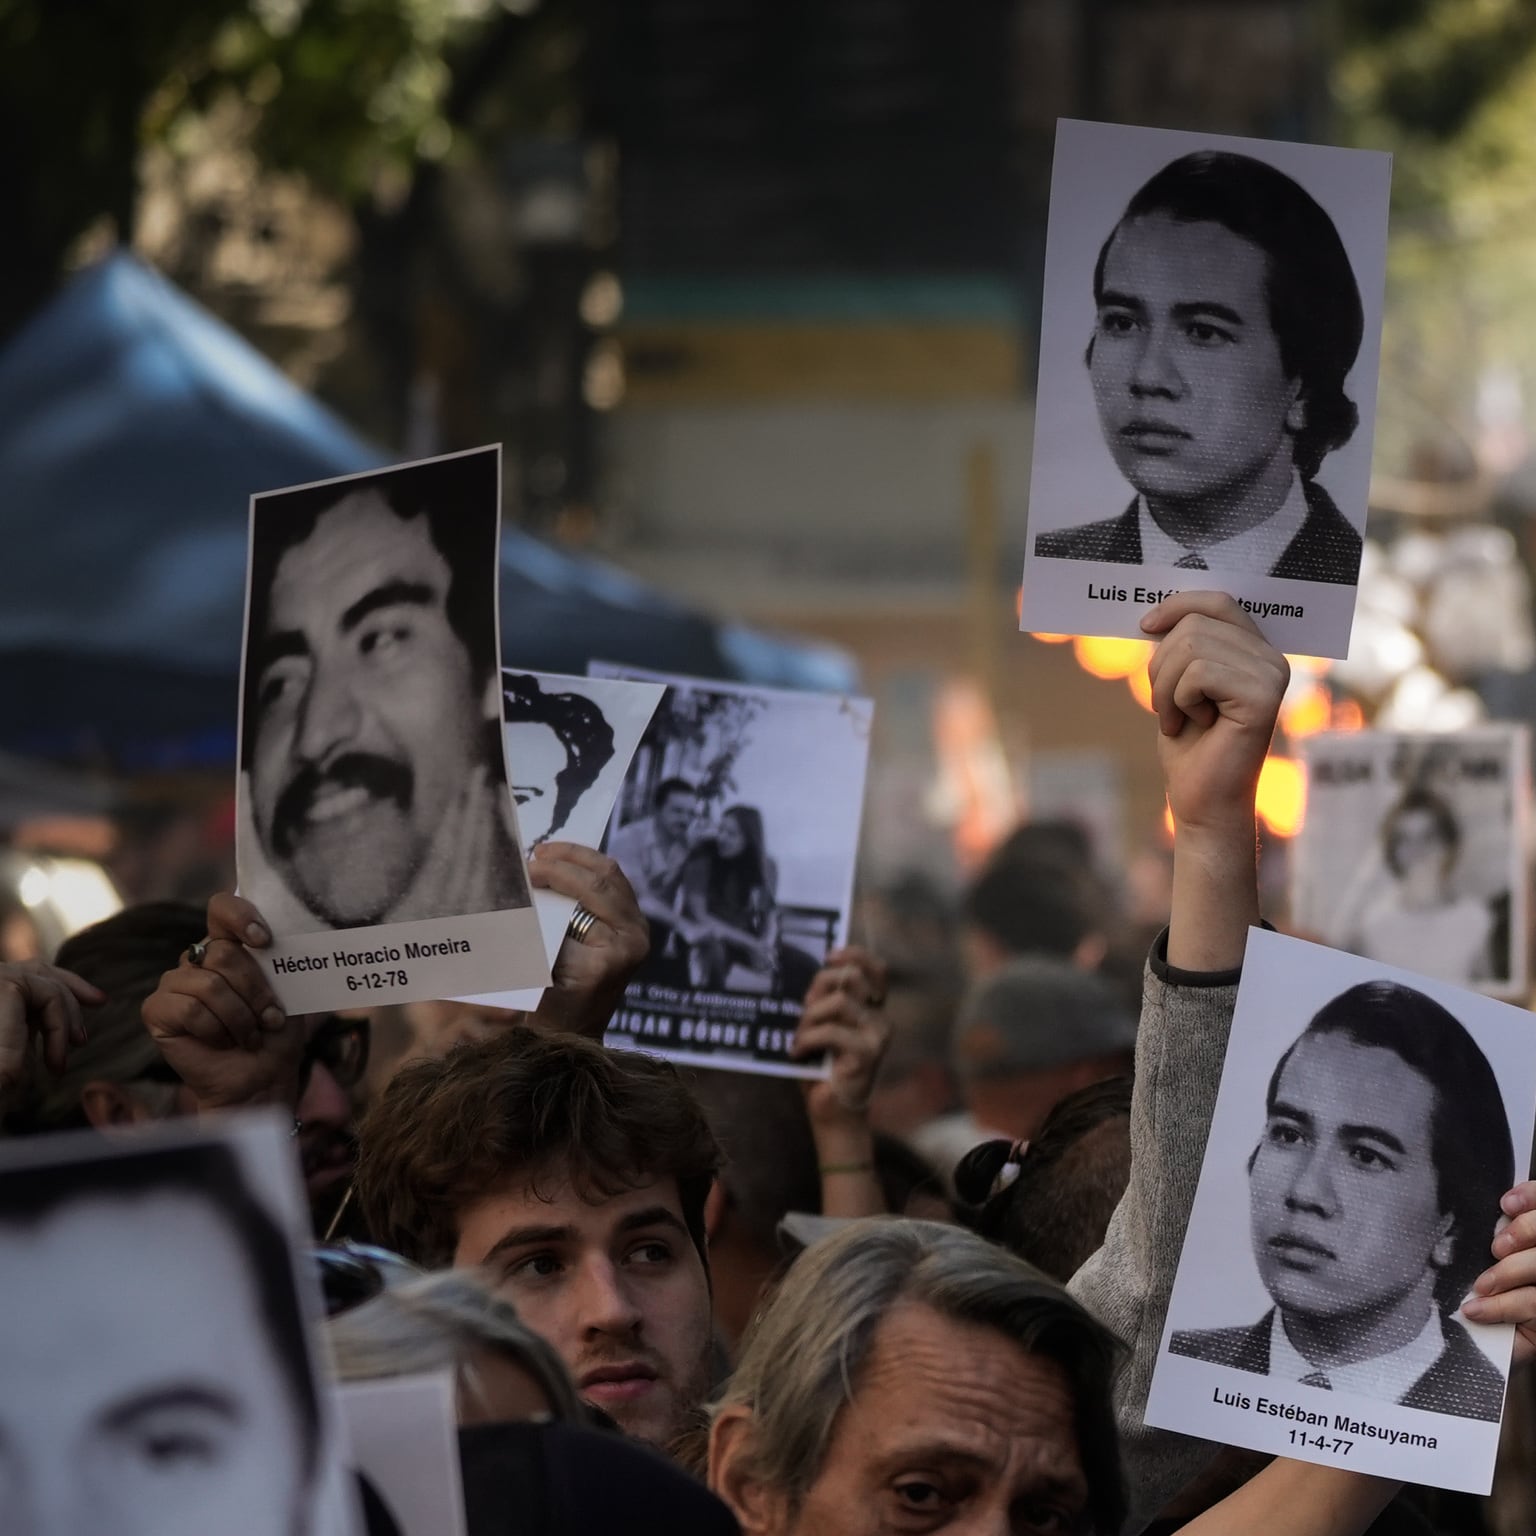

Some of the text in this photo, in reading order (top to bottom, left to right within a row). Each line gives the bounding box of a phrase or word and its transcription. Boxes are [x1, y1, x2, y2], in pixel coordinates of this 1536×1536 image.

[1088, 583, 1127, 602] Luis
[1237, 599, 1304, 618] tsuyama
[272, 937, 472, 975] Héctor Horacio Moreira
[346, 970, 409, 991] 6-12-78
[757, 1026, 796, 1052] EST
[1213, 1387, 1438, 1450] Luis Estéban Matsuyama
[1288, 1429, 1354, 1456] 11-4-77
